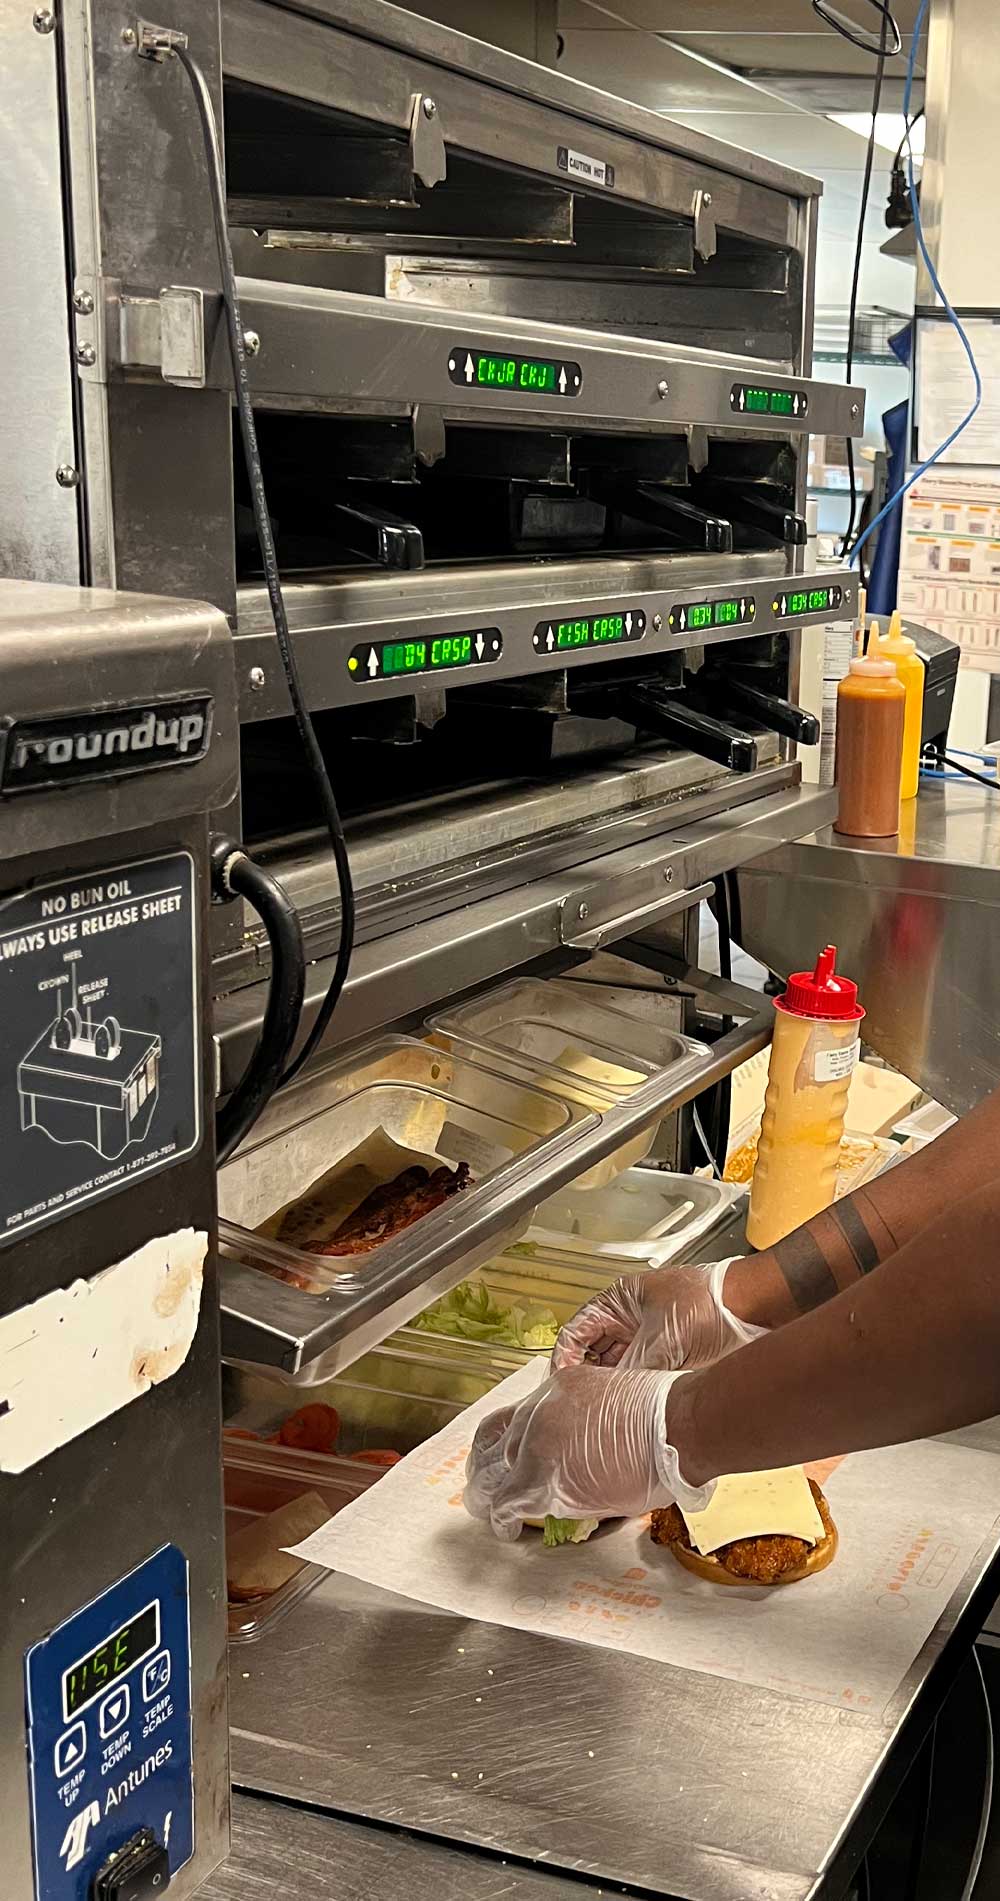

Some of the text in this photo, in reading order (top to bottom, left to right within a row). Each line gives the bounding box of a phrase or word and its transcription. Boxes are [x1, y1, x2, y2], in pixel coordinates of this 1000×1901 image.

[557, 623, 589, 644] FISH
[14, 712, 204, 769] roundup
[42, 880, 131, 917] NO BUN OIL
[49, 922, 78, 945] USE
[81, 907, 139, 936] RELEASE
[142, 895, 182, 921] SHEET
[38, 974, 69, 991] CROWN
[78, 977, 109, 995] RELEASE
[82, 989, 106, 1005] SHEET
[6, 1212, 23, 1227] FOR
[23, 1203, 48, 1219] PARTS
[47, 1193, 65, 1208] AND
[65, 1179, 94, 1200] SERVICE
[94, 1165, 126, 1186] CONTACT
[143, 1704, 174, 1738] SCALE
[144, 1695, 171, 1722] TEMP
[101, 1741, 131, 1776] DOWN
[102, 1731, 130, 1760] TEMP
[57, 1769, 86, 1801] TEMP
[105, 1740, 173, 1816] Antunes
[65, 1788, 80, 1808] UP
